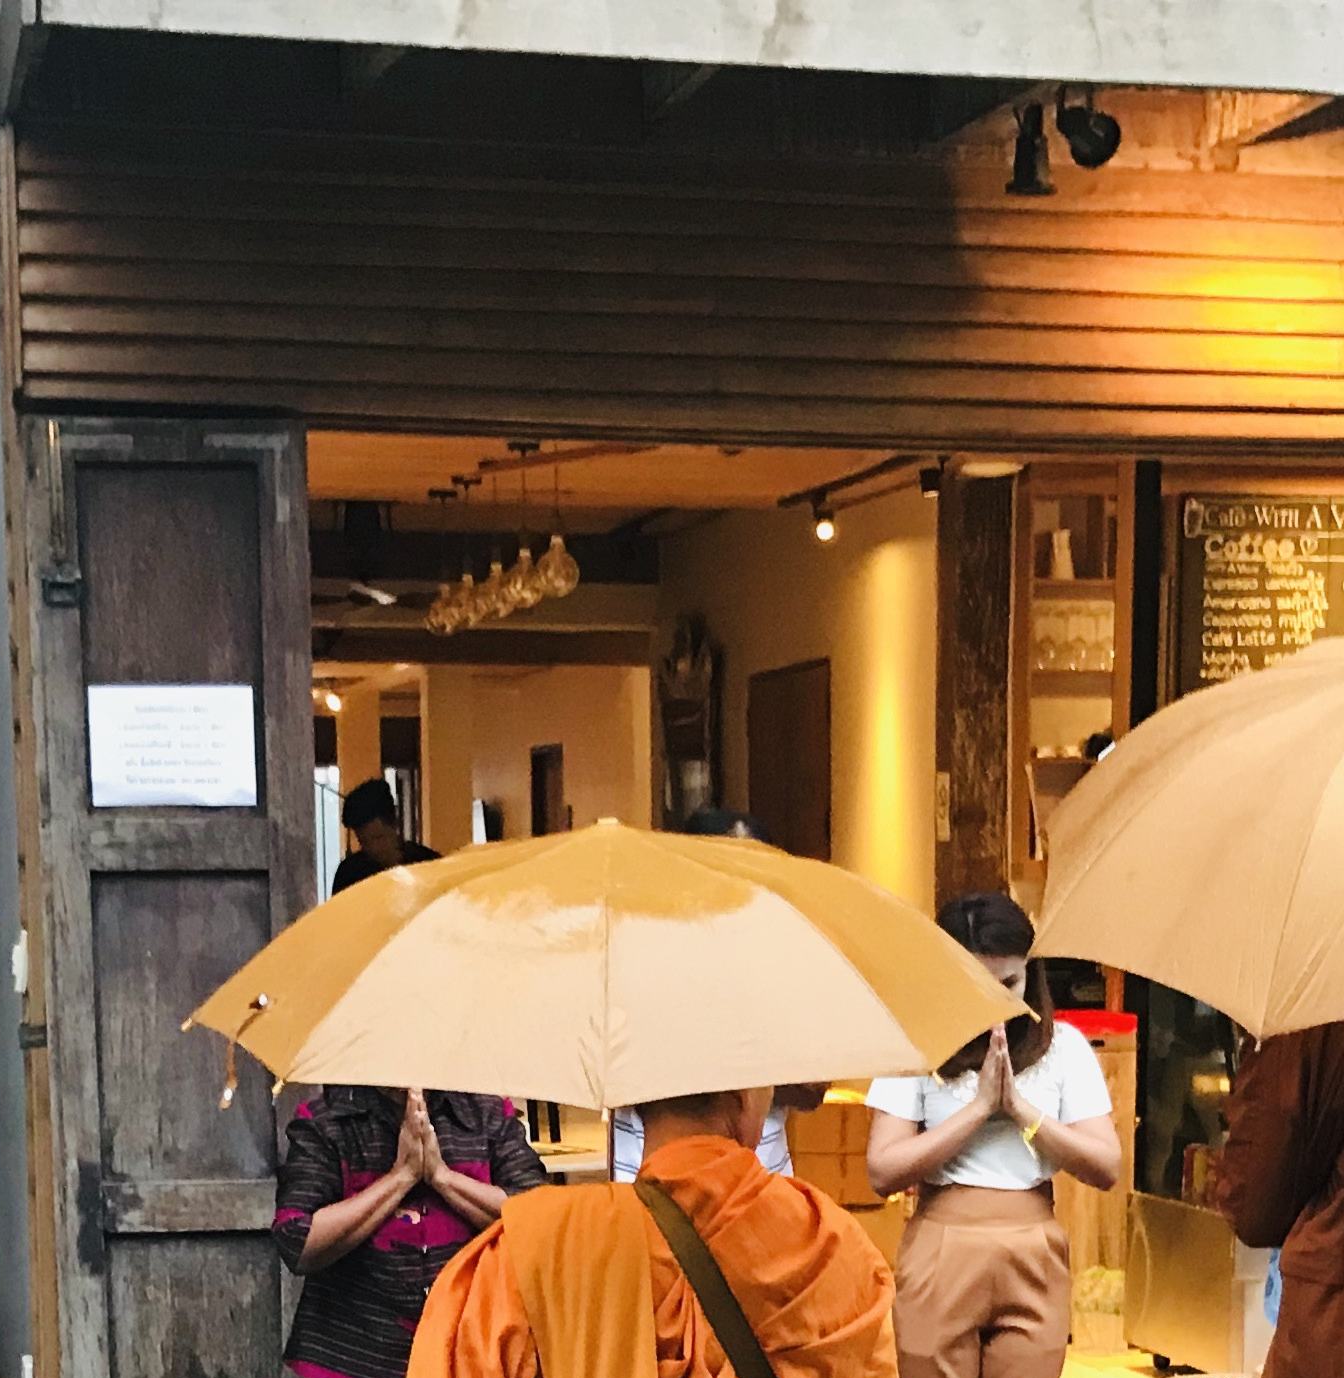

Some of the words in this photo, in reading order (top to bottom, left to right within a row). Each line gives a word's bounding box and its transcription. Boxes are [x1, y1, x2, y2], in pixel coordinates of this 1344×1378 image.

[1306, 504, 1322, 529] A
[1205, 534, 1295, 560] Coffee
[1237, 631, 1276, 647] Latte
